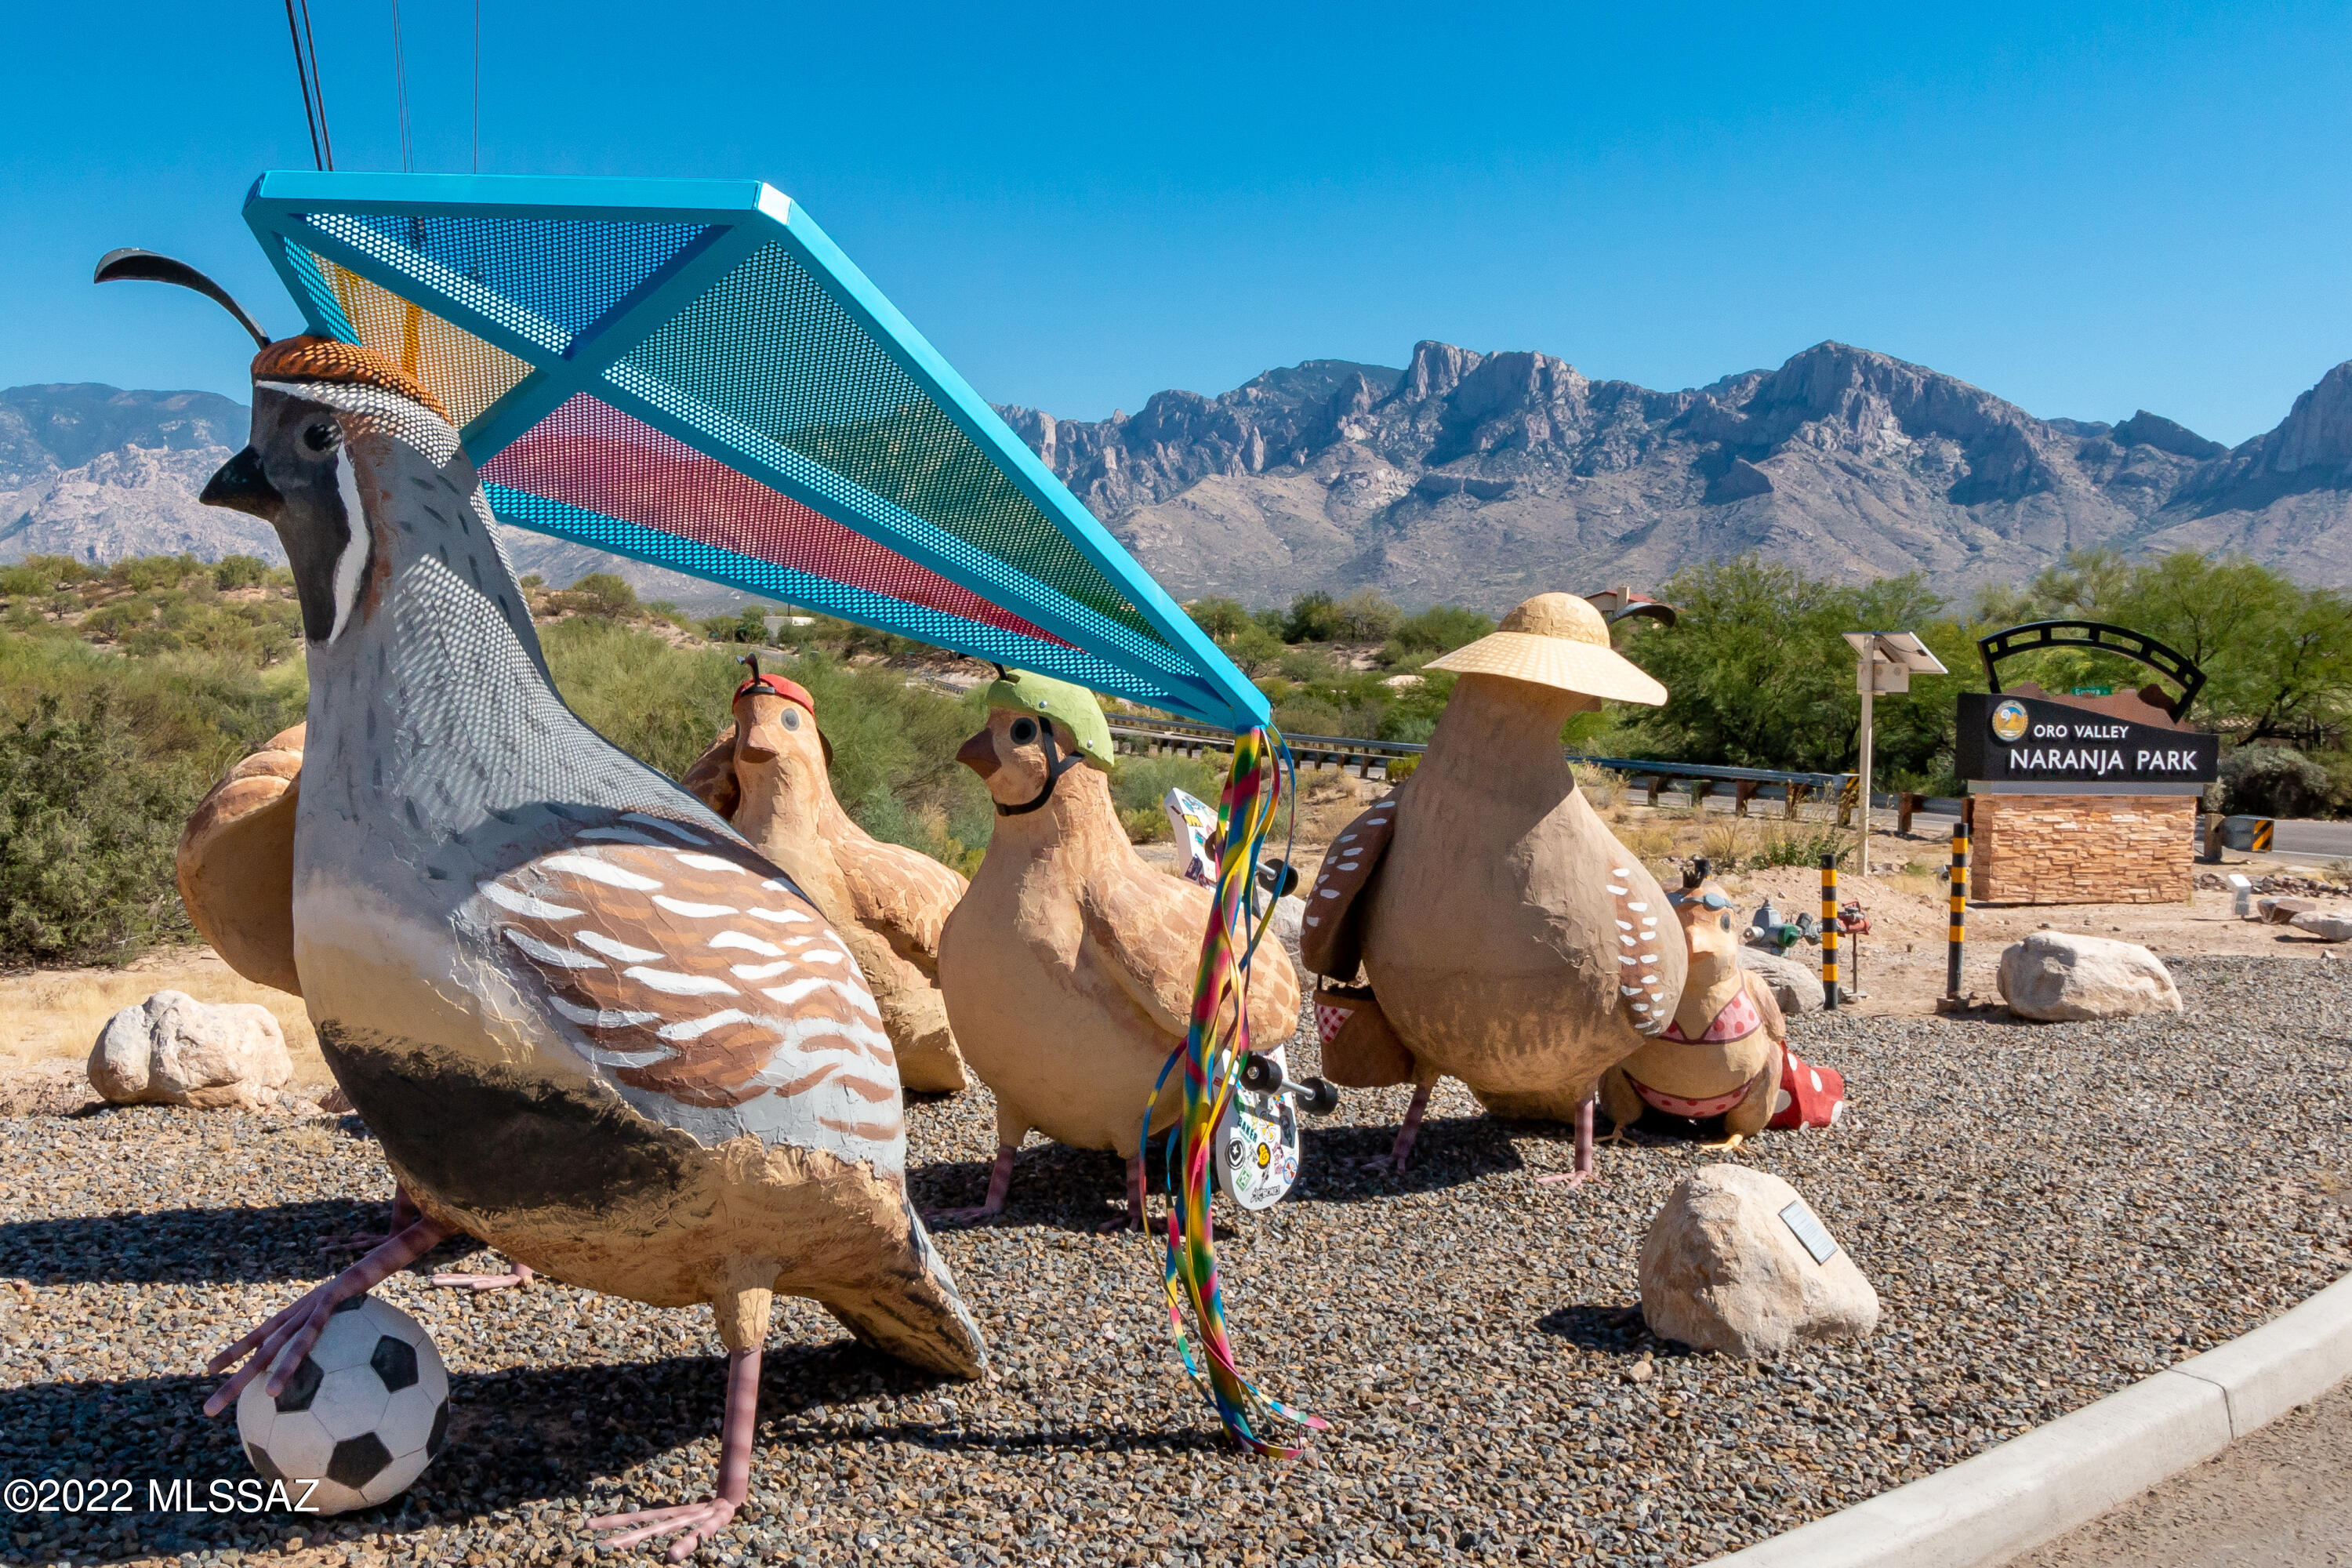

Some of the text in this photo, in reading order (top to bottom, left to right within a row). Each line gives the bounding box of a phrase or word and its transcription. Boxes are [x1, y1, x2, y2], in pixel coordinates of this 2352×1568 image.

[2034, 724, 2129, 739] ORO VALLEY
[2010, 749, 2198, 775] NARANJA PARK
[1237, 1116, 1258, 1143] BAKER
